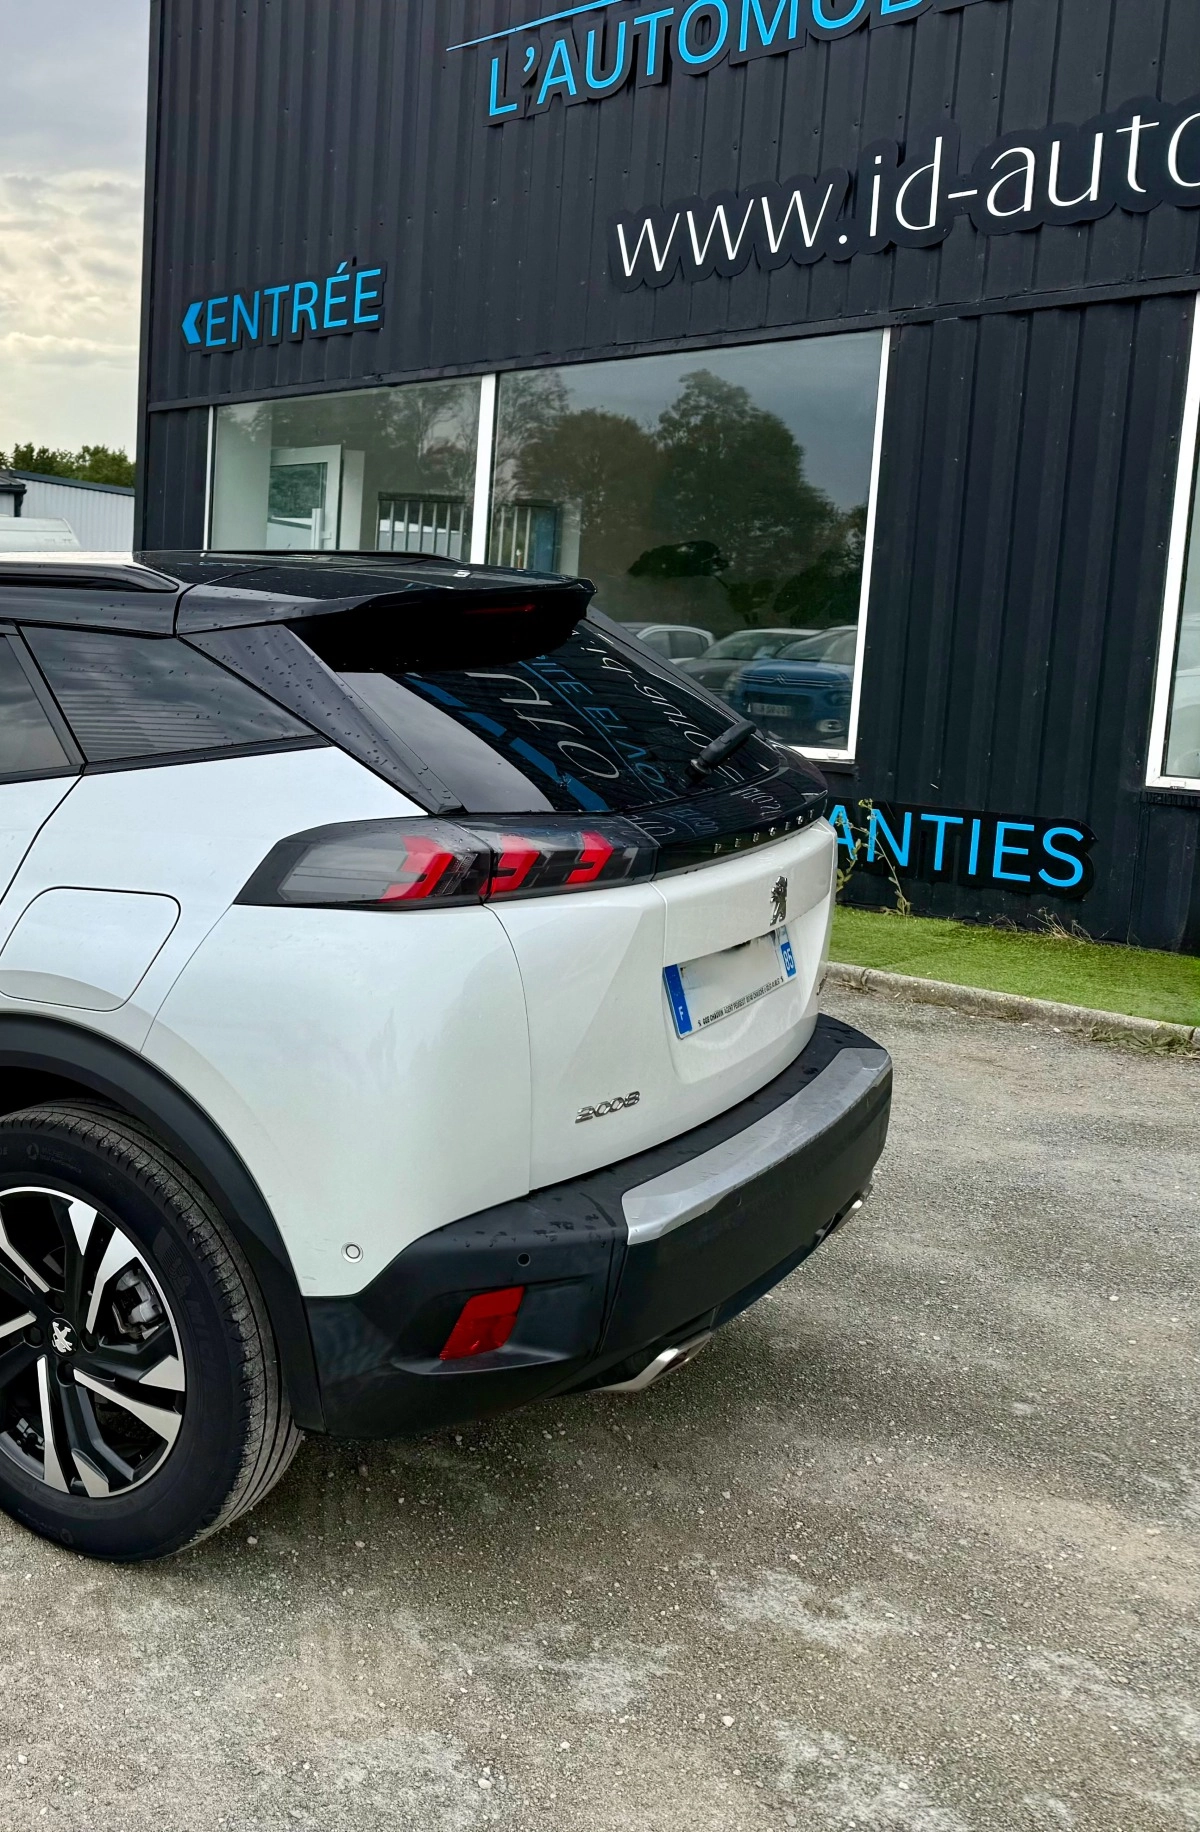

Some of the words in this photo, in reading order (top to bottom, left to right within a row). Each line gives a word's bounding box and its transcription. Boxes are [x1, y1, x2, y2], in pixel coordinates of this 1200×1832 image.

[488, 0, 923, 117] L'AUTOM
[206, 261, 381, 347] ENTRÉE
[574, 1090, 641, 1124] 2008
